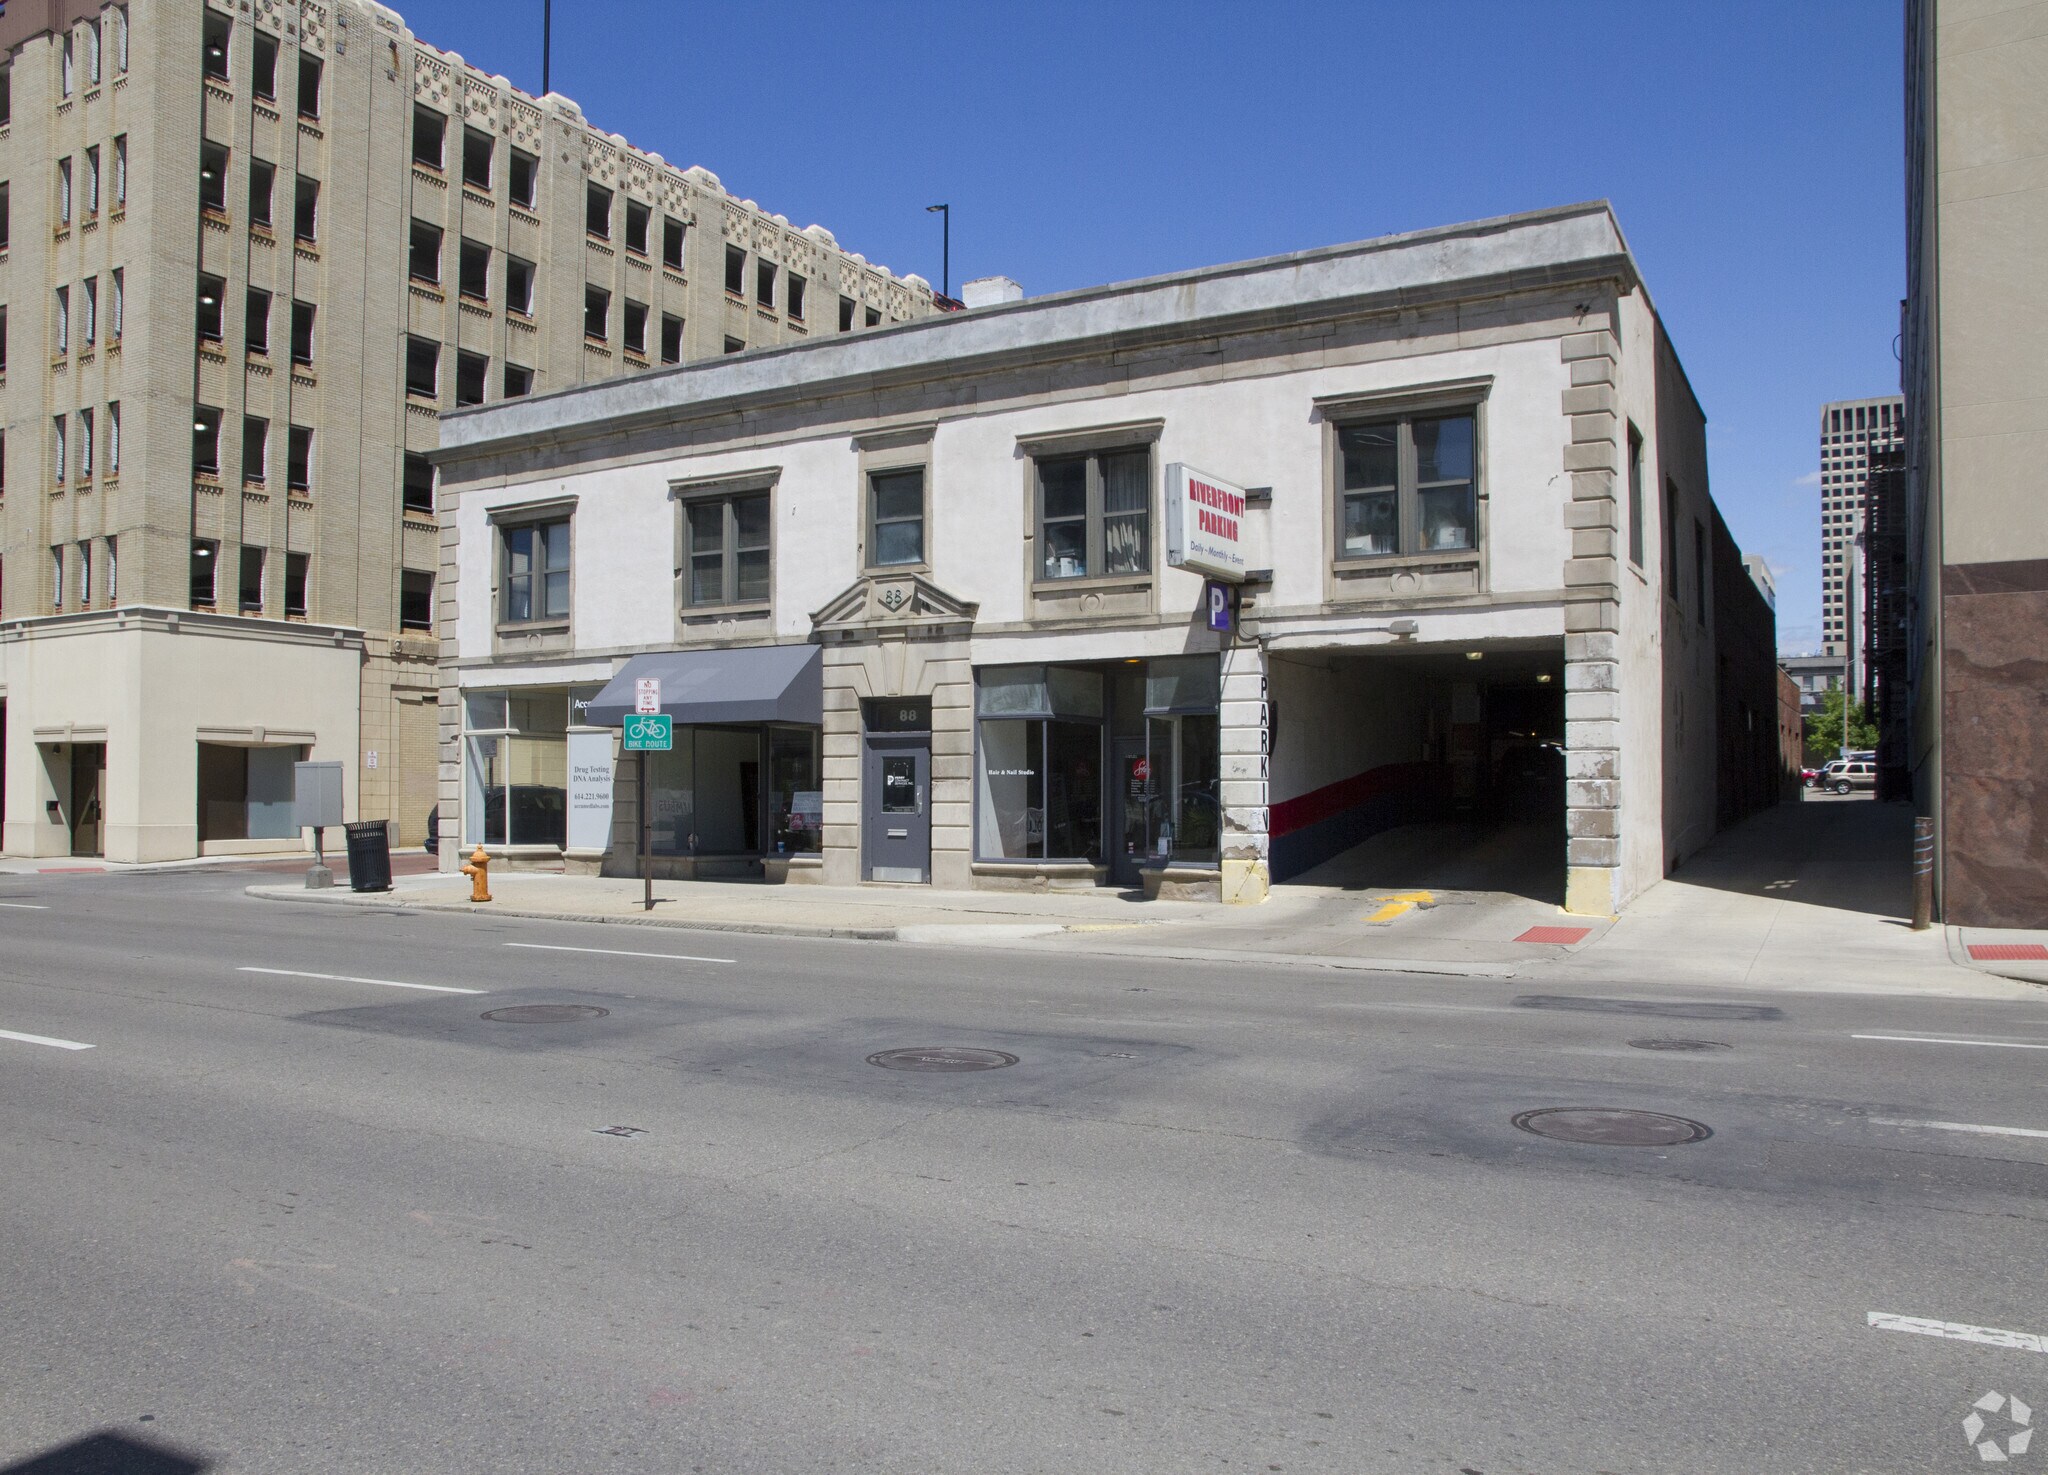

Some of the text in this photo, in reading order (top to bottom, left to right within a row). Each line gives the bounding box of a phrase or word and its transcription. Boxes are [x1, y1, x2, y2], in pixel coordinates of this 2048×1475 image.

[1189, 478, 1245, 519] RIVERFRONT
[1199, 509, 1238, 542] PARKING
[1190, 540, 1204, 555] Daily
[1208, 546, 1229, 563] Monthly
[1232, 553, 1245, 566] Event
[885, 589, 902, 605] 88
[1211, 587, 1224, 626] P
[899, 709, 917, 722] 88
[628, 740, 667, 748] BIKE ROUTE
[574, 766, 609, 774] Drug Testing
[588, 775, 610, 783] Analysis
